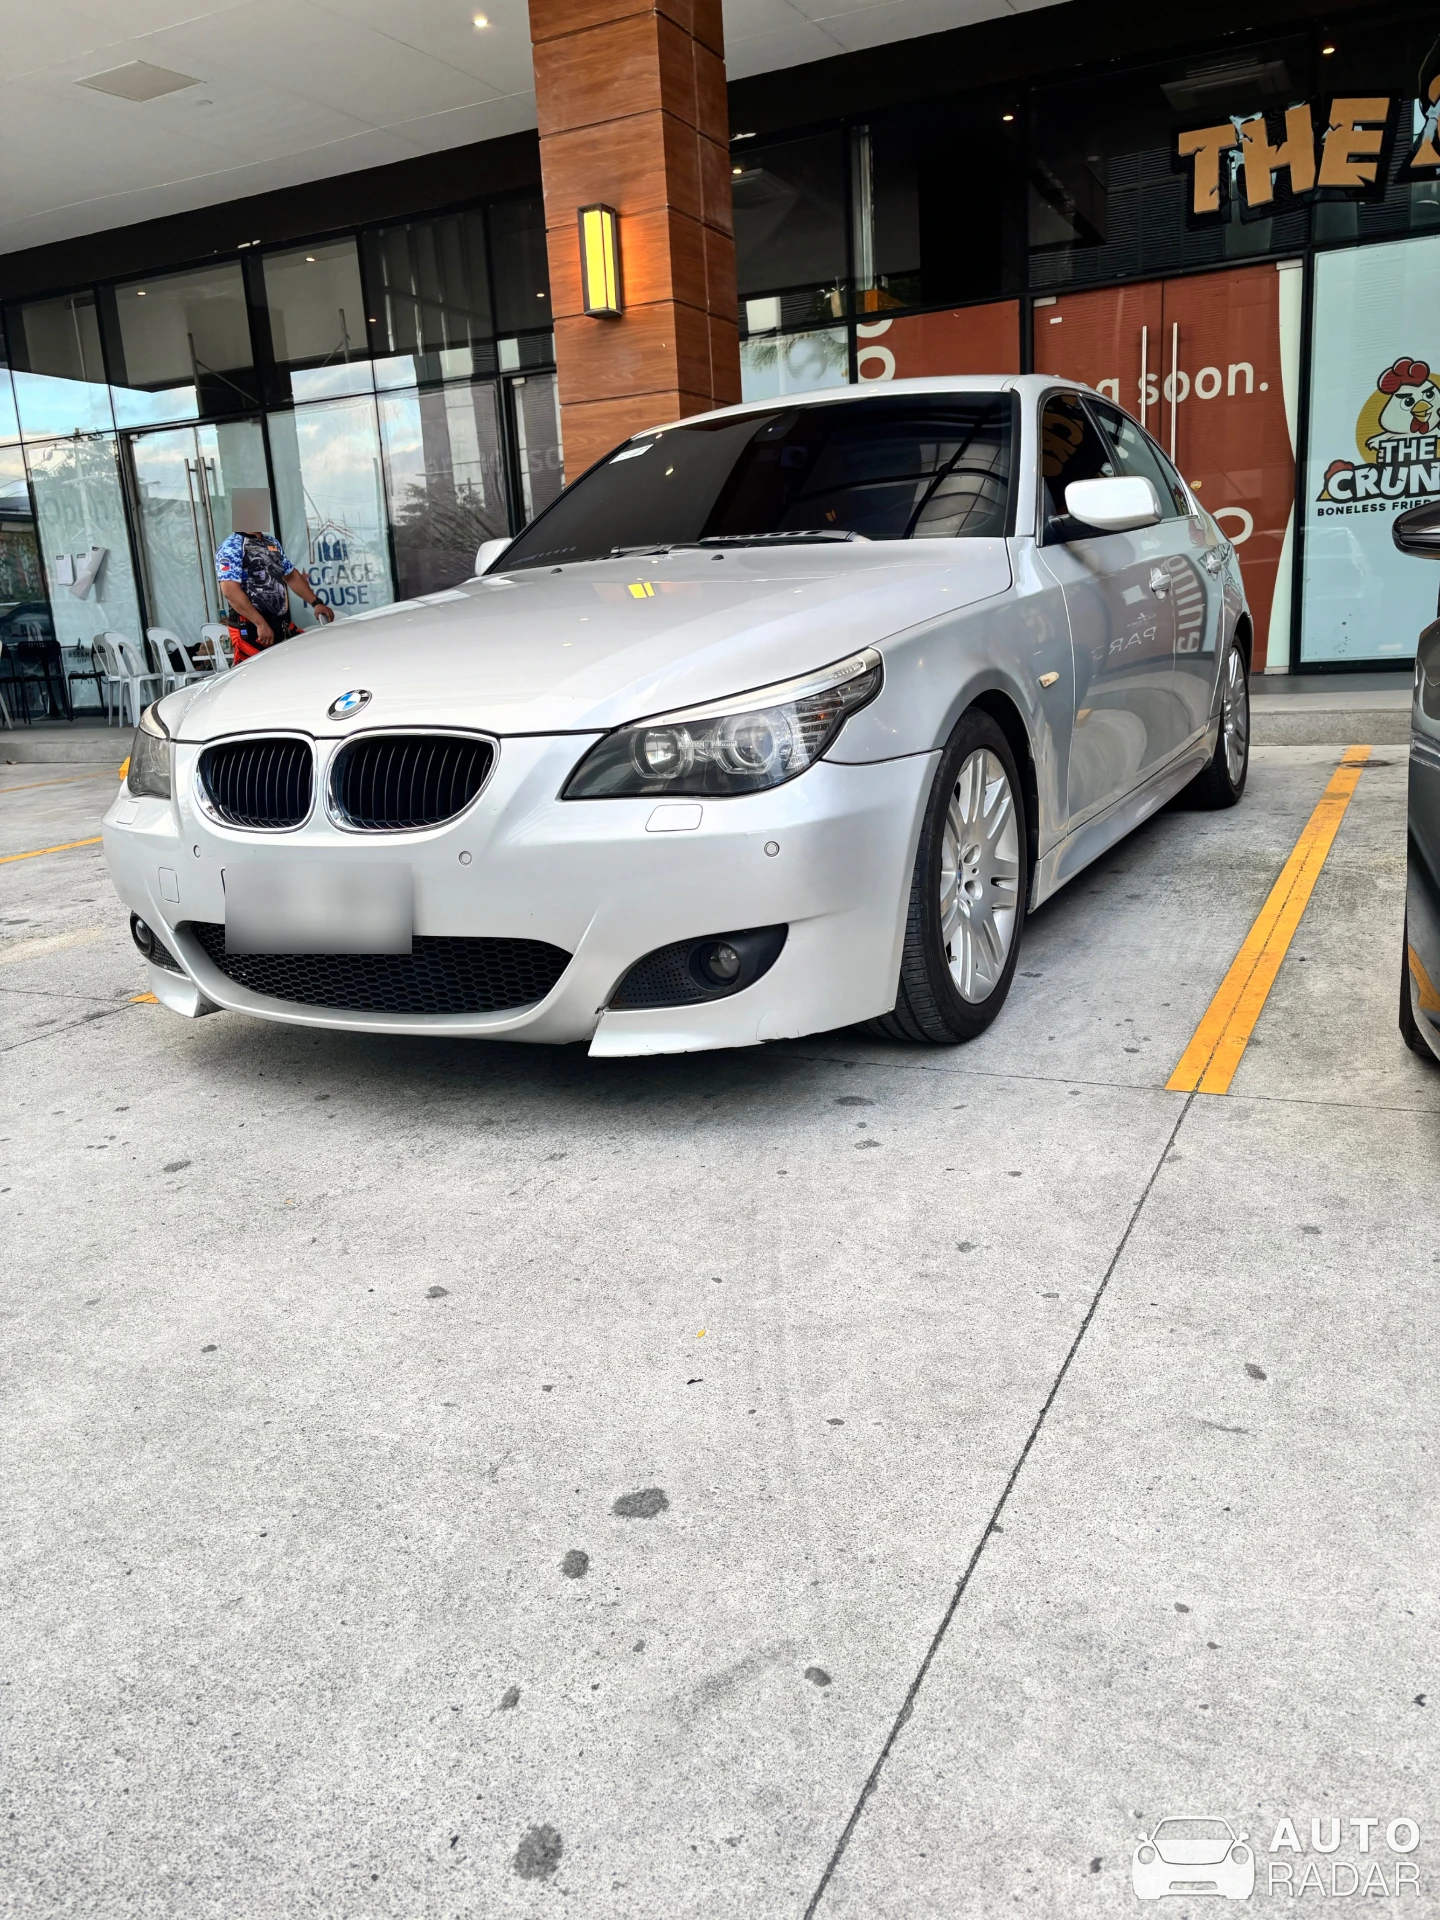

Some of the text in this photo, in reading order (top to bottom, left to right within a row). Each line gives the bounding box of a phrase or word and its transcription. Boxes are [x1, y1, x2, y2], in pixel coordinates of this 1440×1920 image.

[1179, 97, 1390, 214] THE
[1138, 362, 1269, 406] soon.
[1381, 438, 1435, 464] THE
[1317, 502, 1386, 517] BONELESS
[308, 562, 375, 586] GGAGE
[303, 584, 370, 608] OUSE
